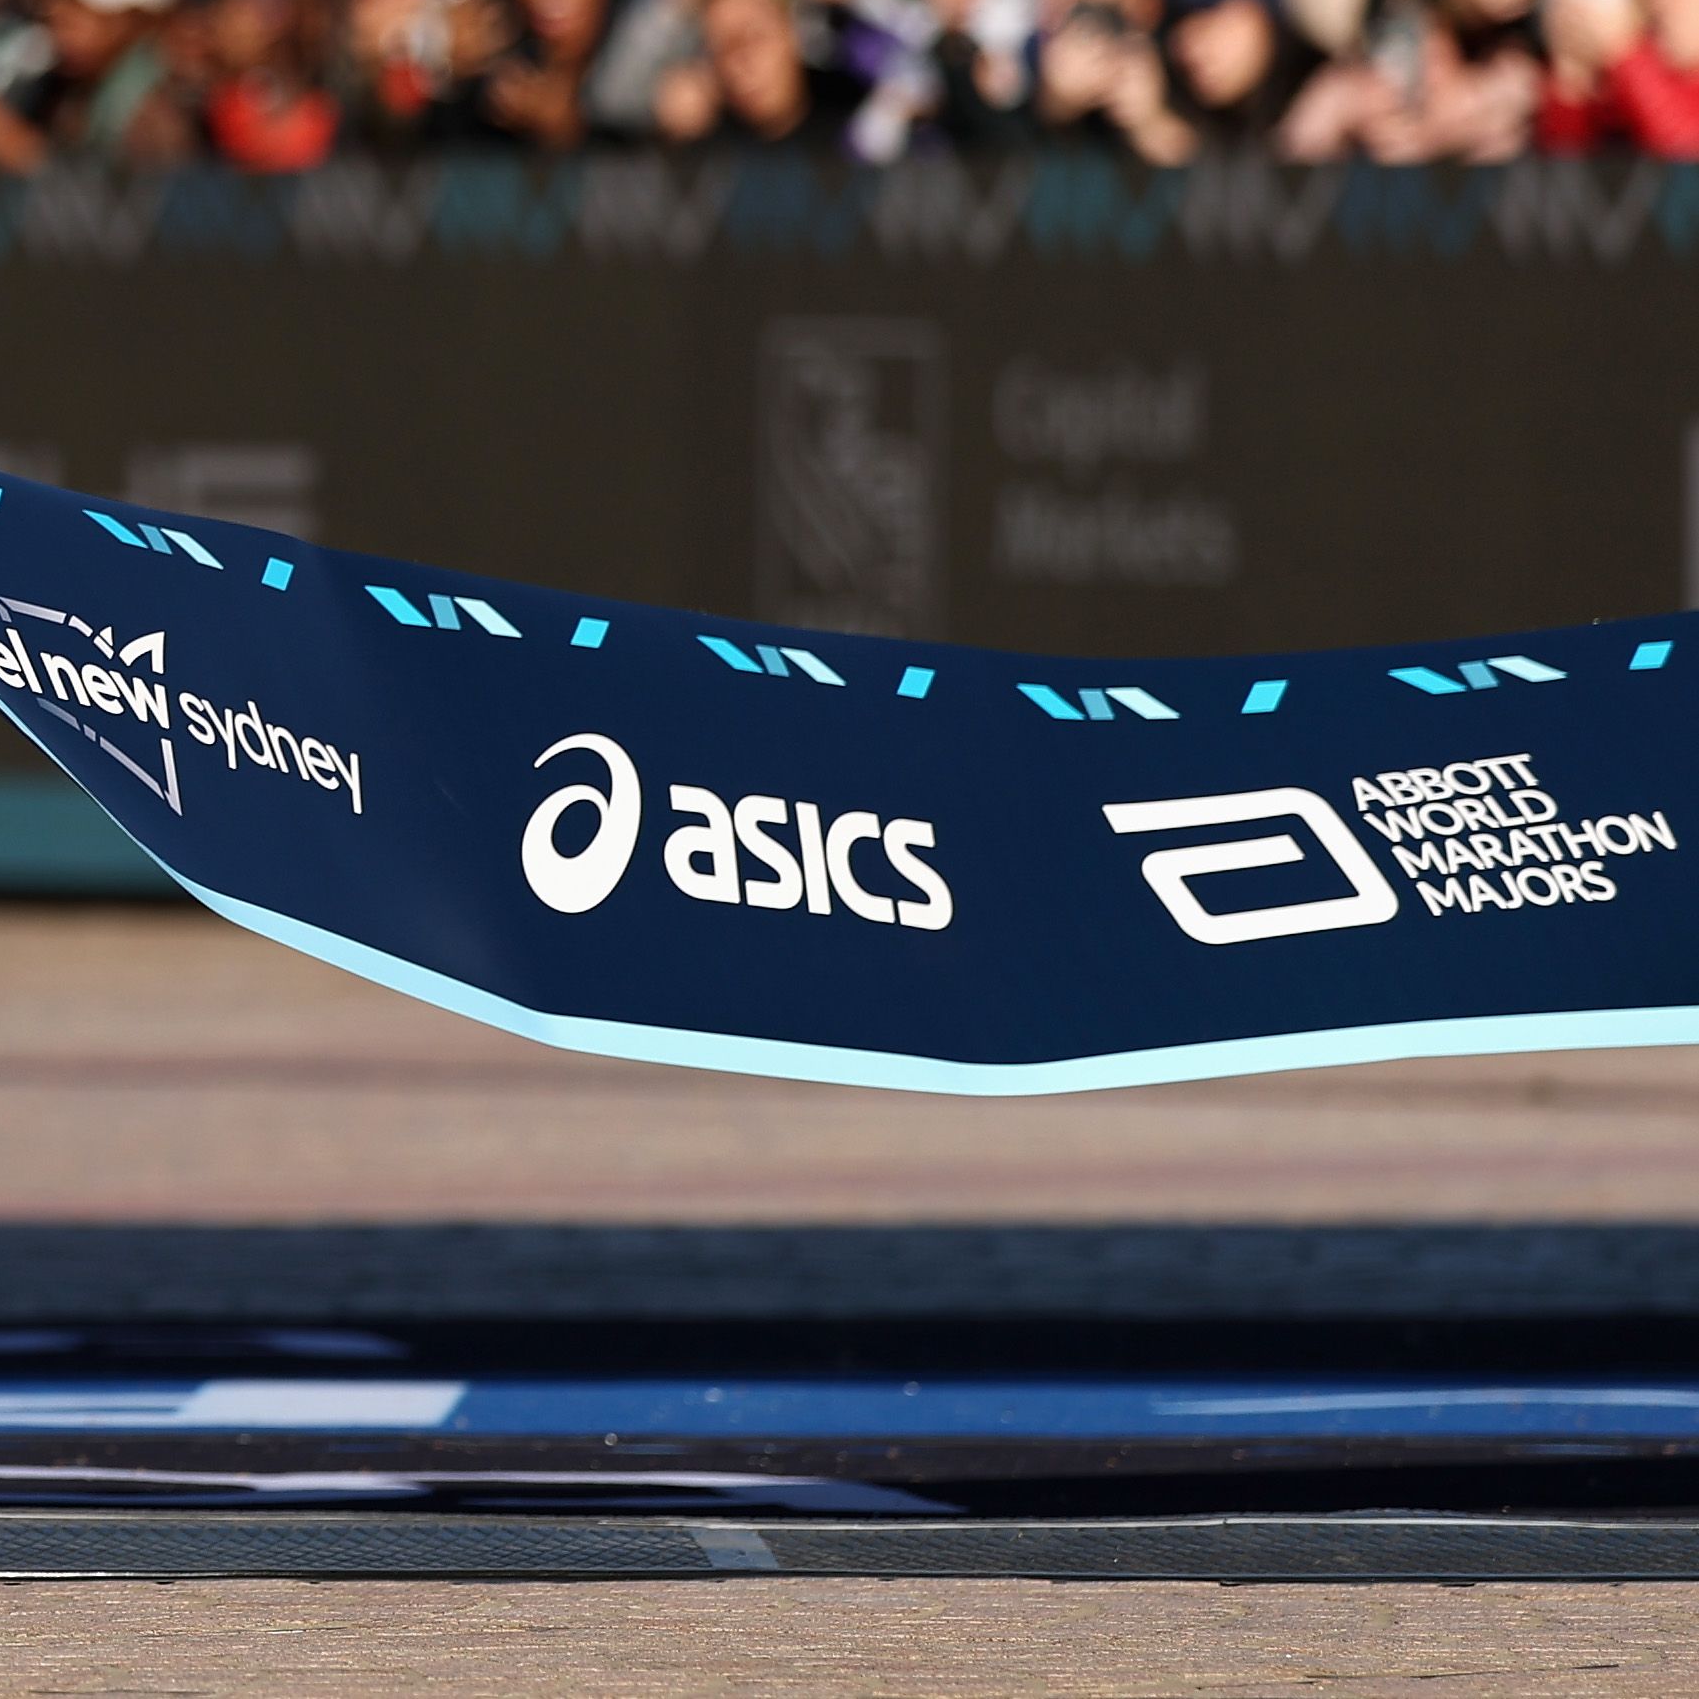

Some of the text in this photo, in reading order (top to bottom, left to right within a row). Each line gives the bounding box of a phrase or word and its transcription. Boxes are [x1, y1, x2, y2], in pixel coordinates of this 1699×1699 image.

[40, 649, 170, 730] new
[178, 691, 362, 814] sydney
[1352, 753, 1540, 812] ABBOTT
[1363, 788, 1558, 843] WORLD
[1391, 811, 1678, 879] MARATHON
[1415, 860, 1618, 917] MAJORS
